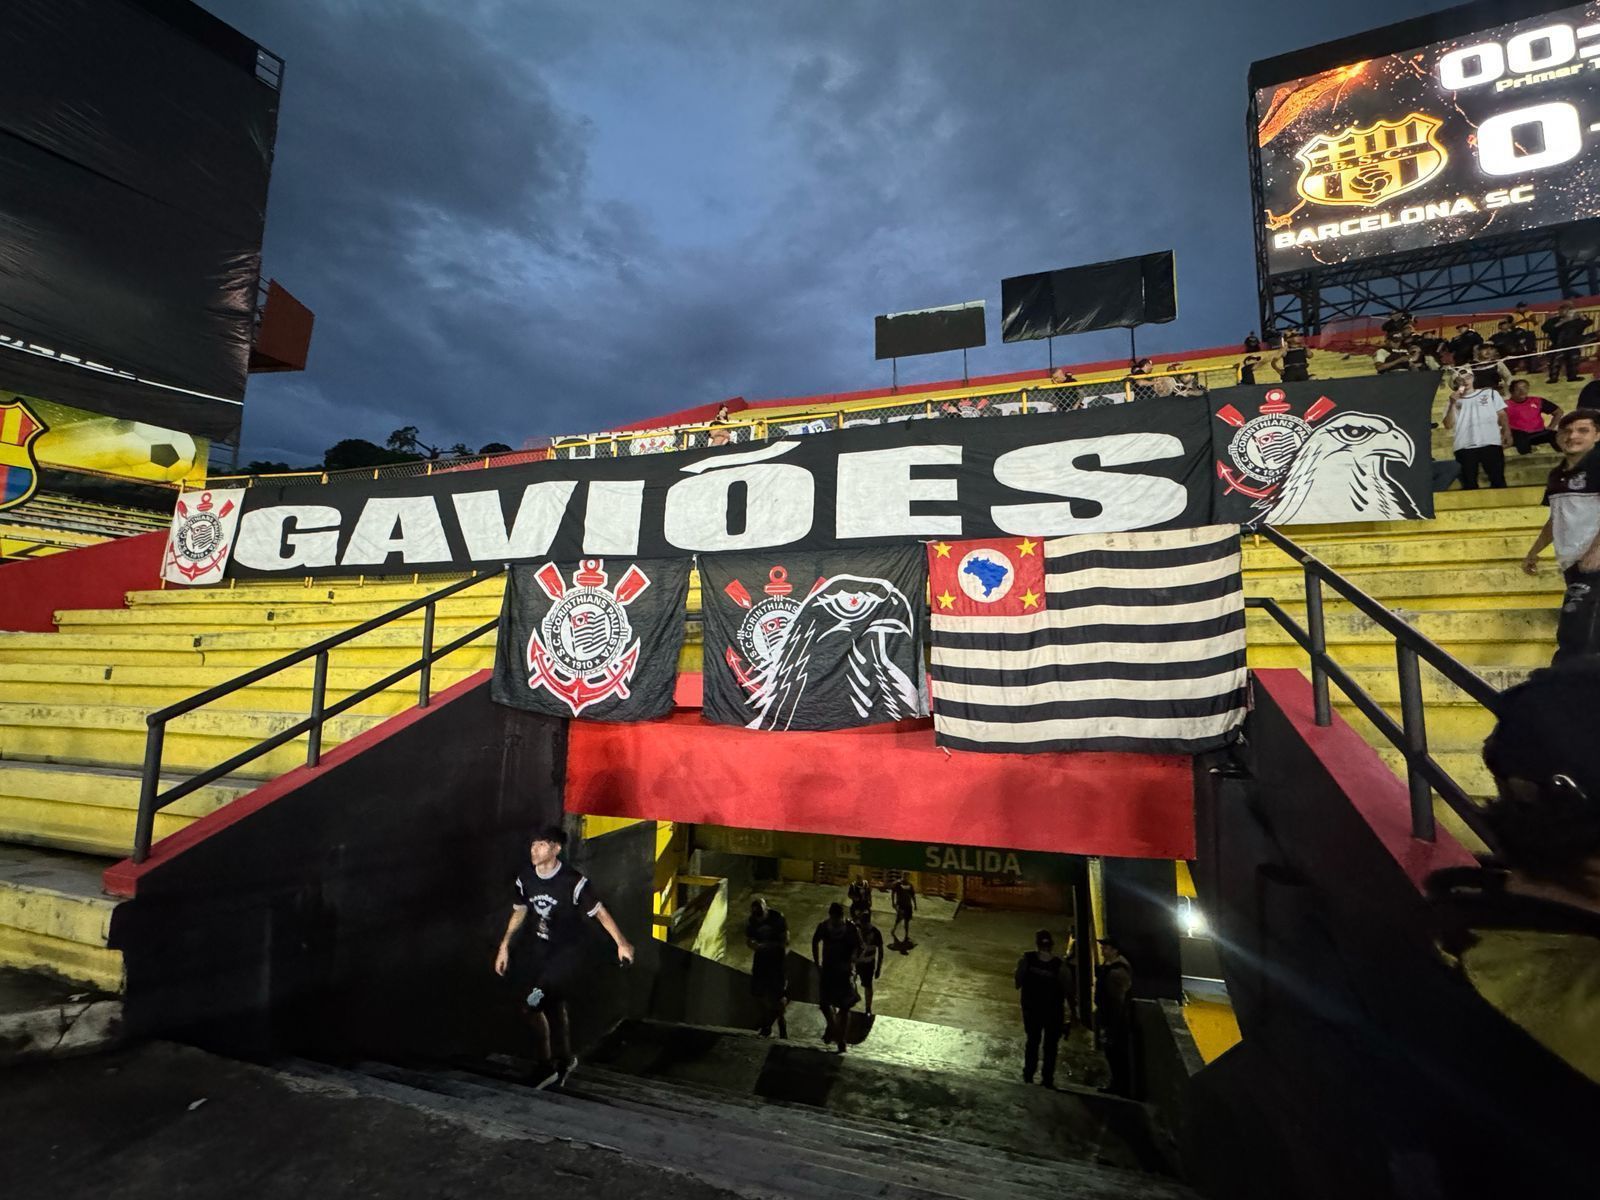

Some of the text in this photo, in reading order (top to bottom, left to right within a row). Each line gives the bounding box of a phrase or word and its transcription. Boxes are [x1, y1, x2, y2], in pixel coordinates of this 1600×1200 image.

[1495, 63, 1584, 92] Primer
[1477, 102, 1582, 175] 0
[1274, 184, 1535, 249] BARCELONA SC
[1238, 420, 1295, 453] CORINTHIANS
[552, 595, 608, 633] CORINTHIANS
[601, 608, 619, 658] PAULISTA
[744, 602, 799, 637] CORINTHIANS
[572, 660, 593, 670] 1910
[926, 845, 1022, 876] SALIDA
